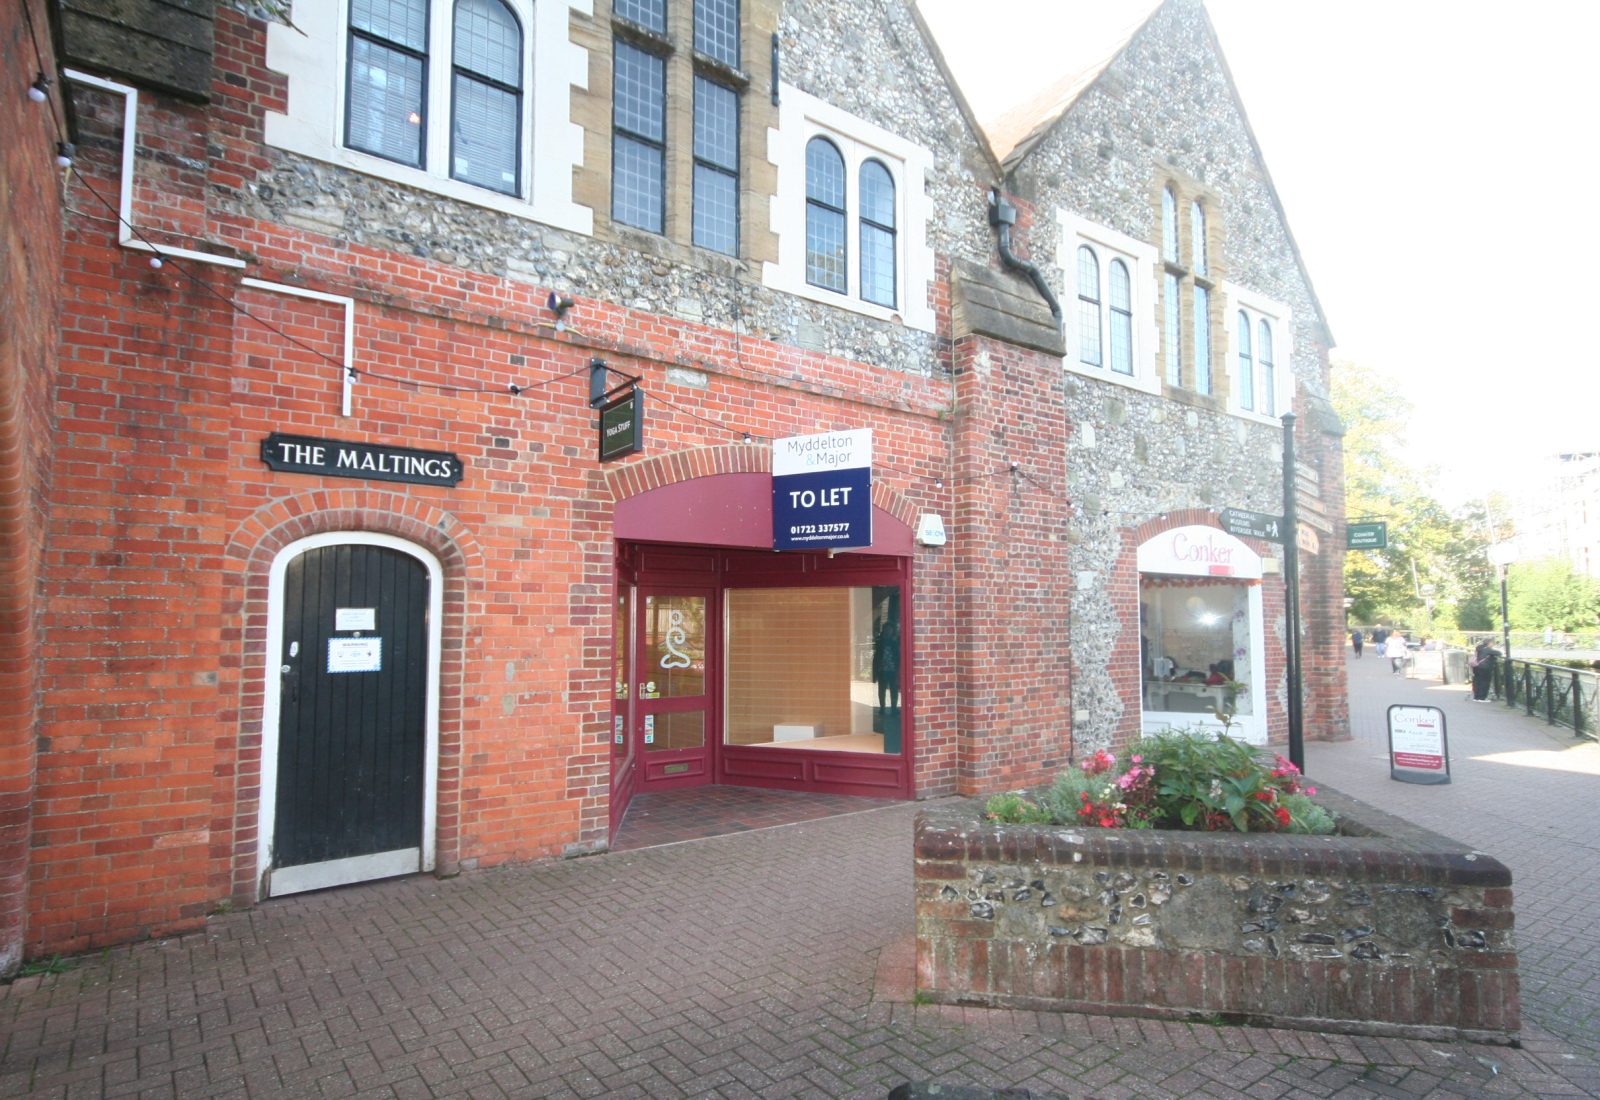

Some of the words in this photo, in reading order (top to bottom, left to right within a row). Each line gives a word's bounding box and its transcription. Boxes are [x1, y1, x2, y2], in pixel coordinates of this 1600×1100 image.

[606, 427, 618, 438] YOGA
[618, 420, 631, 434] STUFF
[787, 436, 853, 457] Myddelton
[278, 443, 326, 466] THE
[336, 449, 452, 478] MALTINGS
[789, 490, 816, 509] TO
[820, 487, 852, 507] LET
[1229, 510, 1256, 521] CATHEDRAL
[790, 525, 816, 535] 01722
[818, 522, 850, 533] 337577
[1173, 532, 1234, 563] Conker
